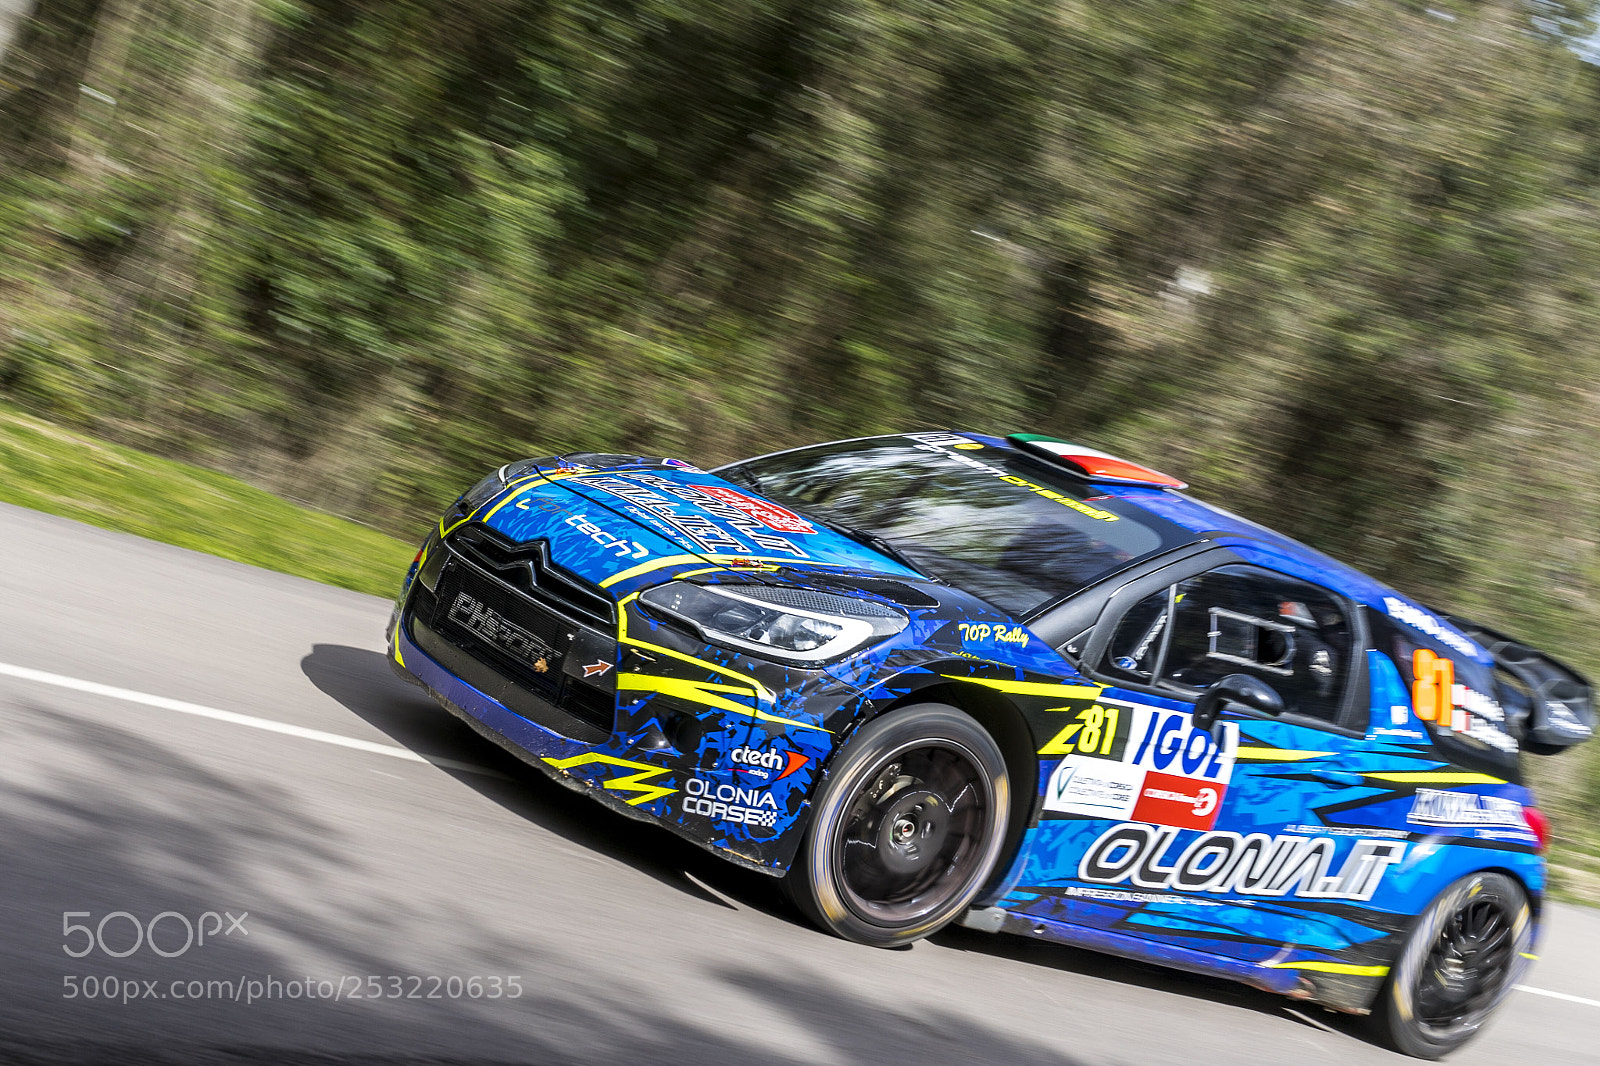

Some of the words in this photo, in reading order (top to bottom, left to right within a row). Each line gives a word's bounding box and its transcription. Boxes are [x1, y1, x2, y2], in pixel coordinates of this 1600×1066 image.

[958, 623, 991, 642] TOP
[993, 624, 1029, 648] Rally
[1412, 648, 1455, 727] 81
[1077, 704, 1120, 755] 81
[1131, 711, 1226, 778] IGOL
[730, 745, 783, 771] ctech
[684, 777, 778, 810] OLONIA
[681, 796, 762, 826] CORSE
